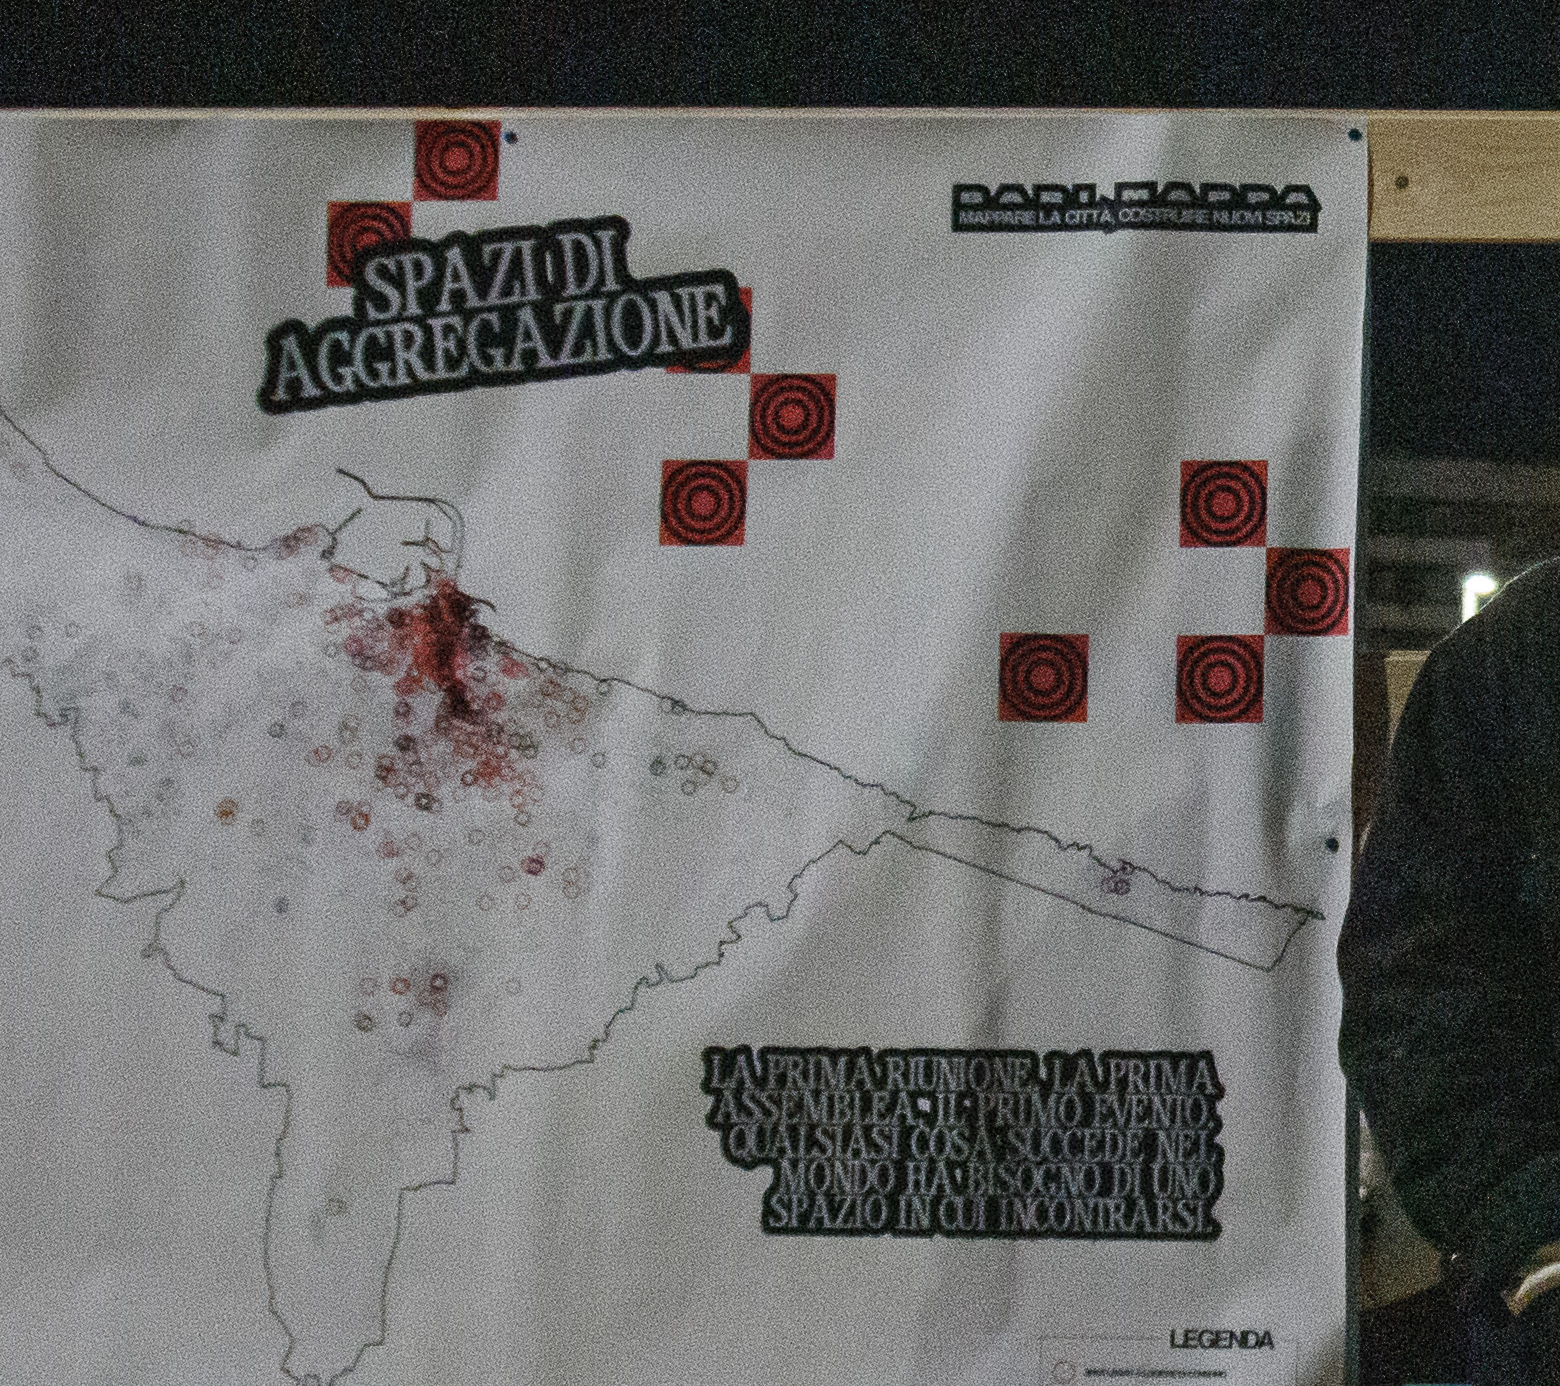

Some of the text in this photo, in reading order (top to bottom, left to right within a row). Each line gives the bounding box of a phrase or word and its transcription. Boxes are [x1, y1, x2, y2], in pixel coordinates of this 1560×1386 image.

[959, 210, 1035, 225] MAPPARE
[1038, 210, 1061, 225] LA
[1265, 211, 1311, 226] SPAZI
[364, 229, 621, 321] SPAZI DI
[272, 282, 733, 402] AGGREGAZIONE
[711, 1055, 753, 1089] LA
[767, 1055, 874, 1090] PRIMA
[1052, 1057, 1096, 1092] LA
[1109, 1058, 1218, 1093] PRIMA
[936, 1092, 967, 1126] IL
[978, 1093, 1082, 1128] PRIMO
[729, 1124, 1218, 1163] QUALSIASI COSA SUCCEDE NEL
[779, 1159, 1217, 1198] MONDO HA BISOGNO DI UNO
[769, 1194, 888, 1229] SPAZIO
[896, 1195, 931, 1229] IN
[939, 1196, 987, 1231] CUI
[1169, 1328, 1275, 1349] LEGENDA
